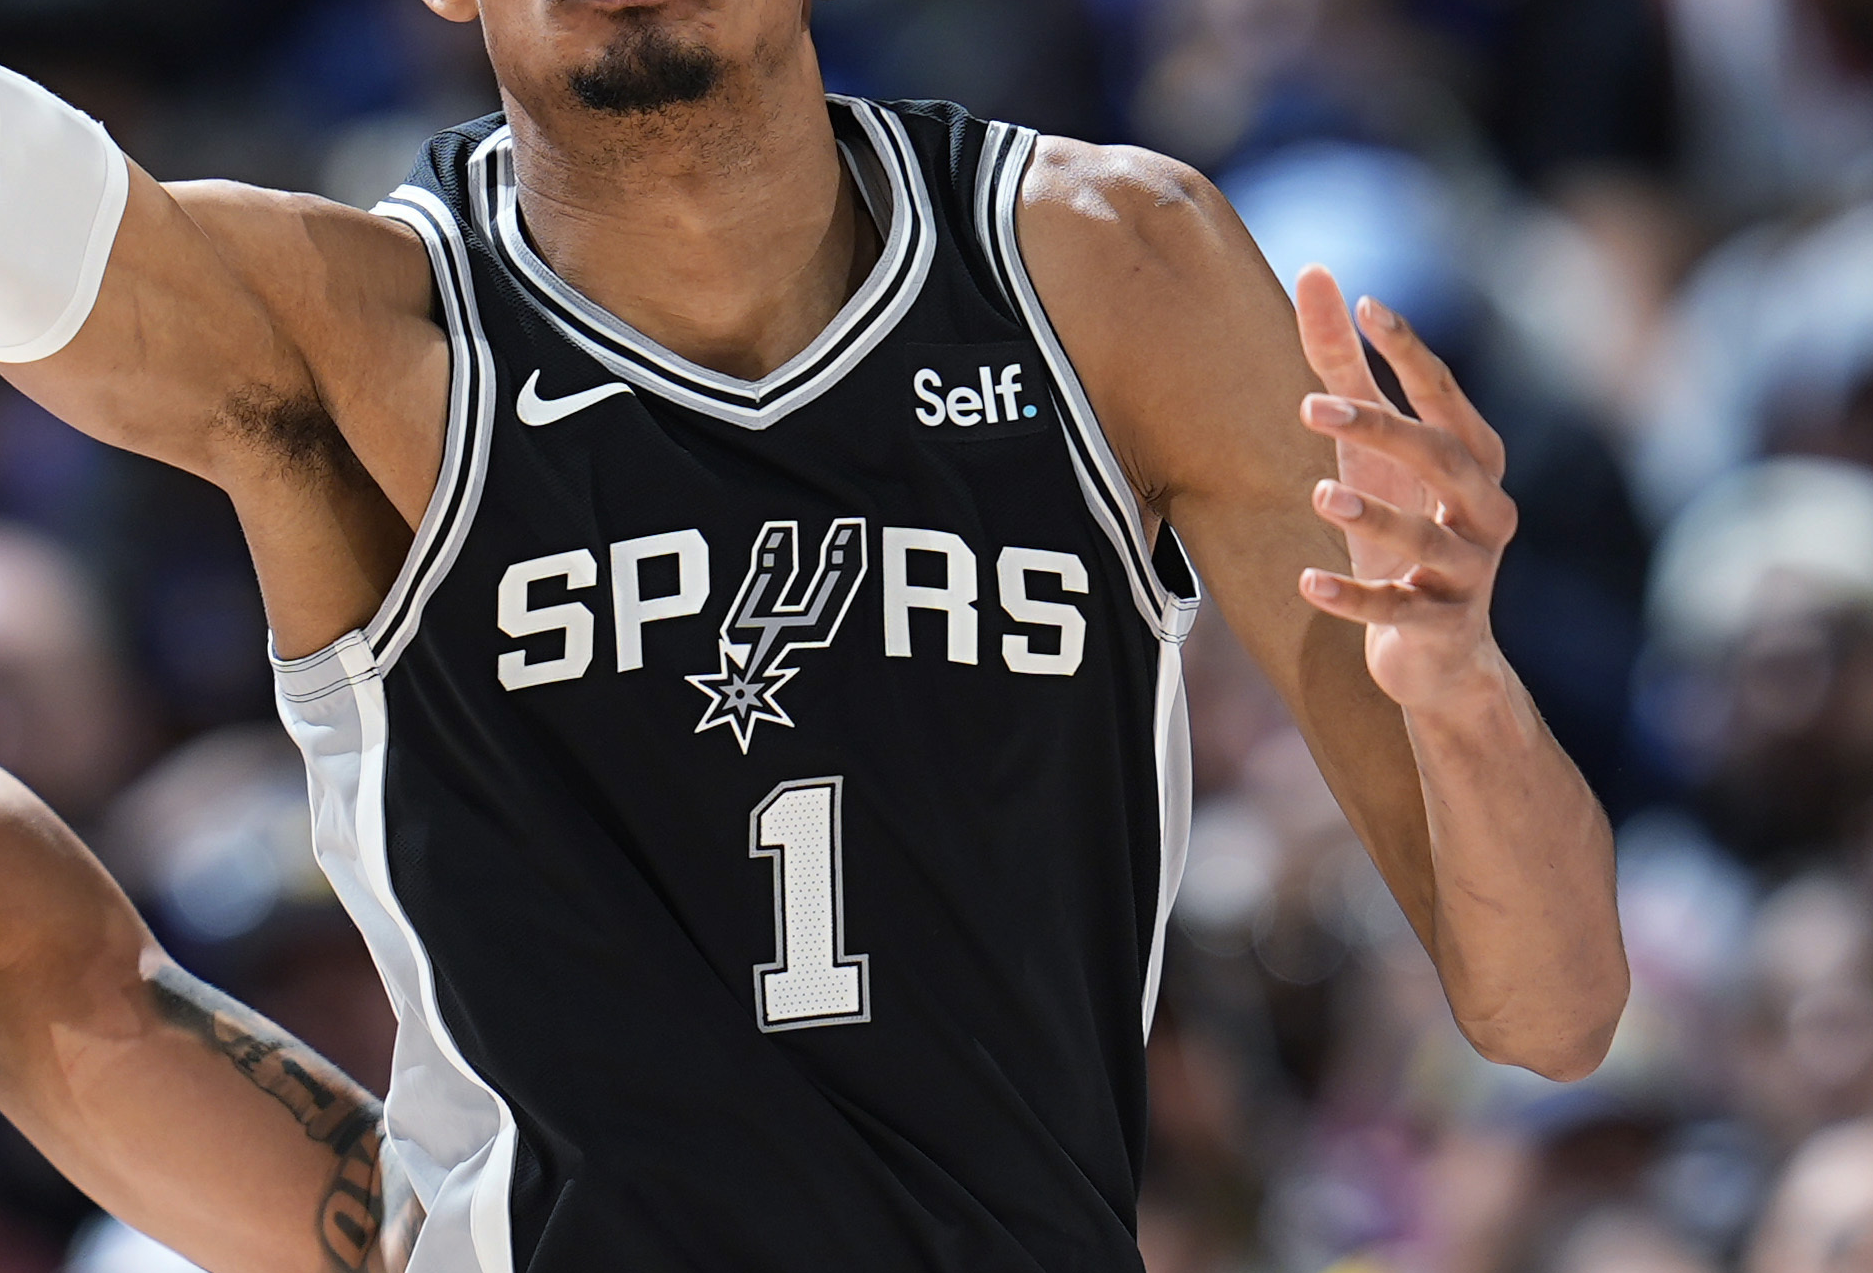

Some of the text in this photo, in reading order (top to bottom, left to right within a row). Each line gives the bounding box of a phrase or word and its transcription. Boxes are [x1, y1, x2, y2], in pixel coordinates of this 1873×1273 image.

[913, 364, 1037, 428] Self.
[497, 518, 1089, 755] SPURS
[749, 775, 871, 1033] 1
